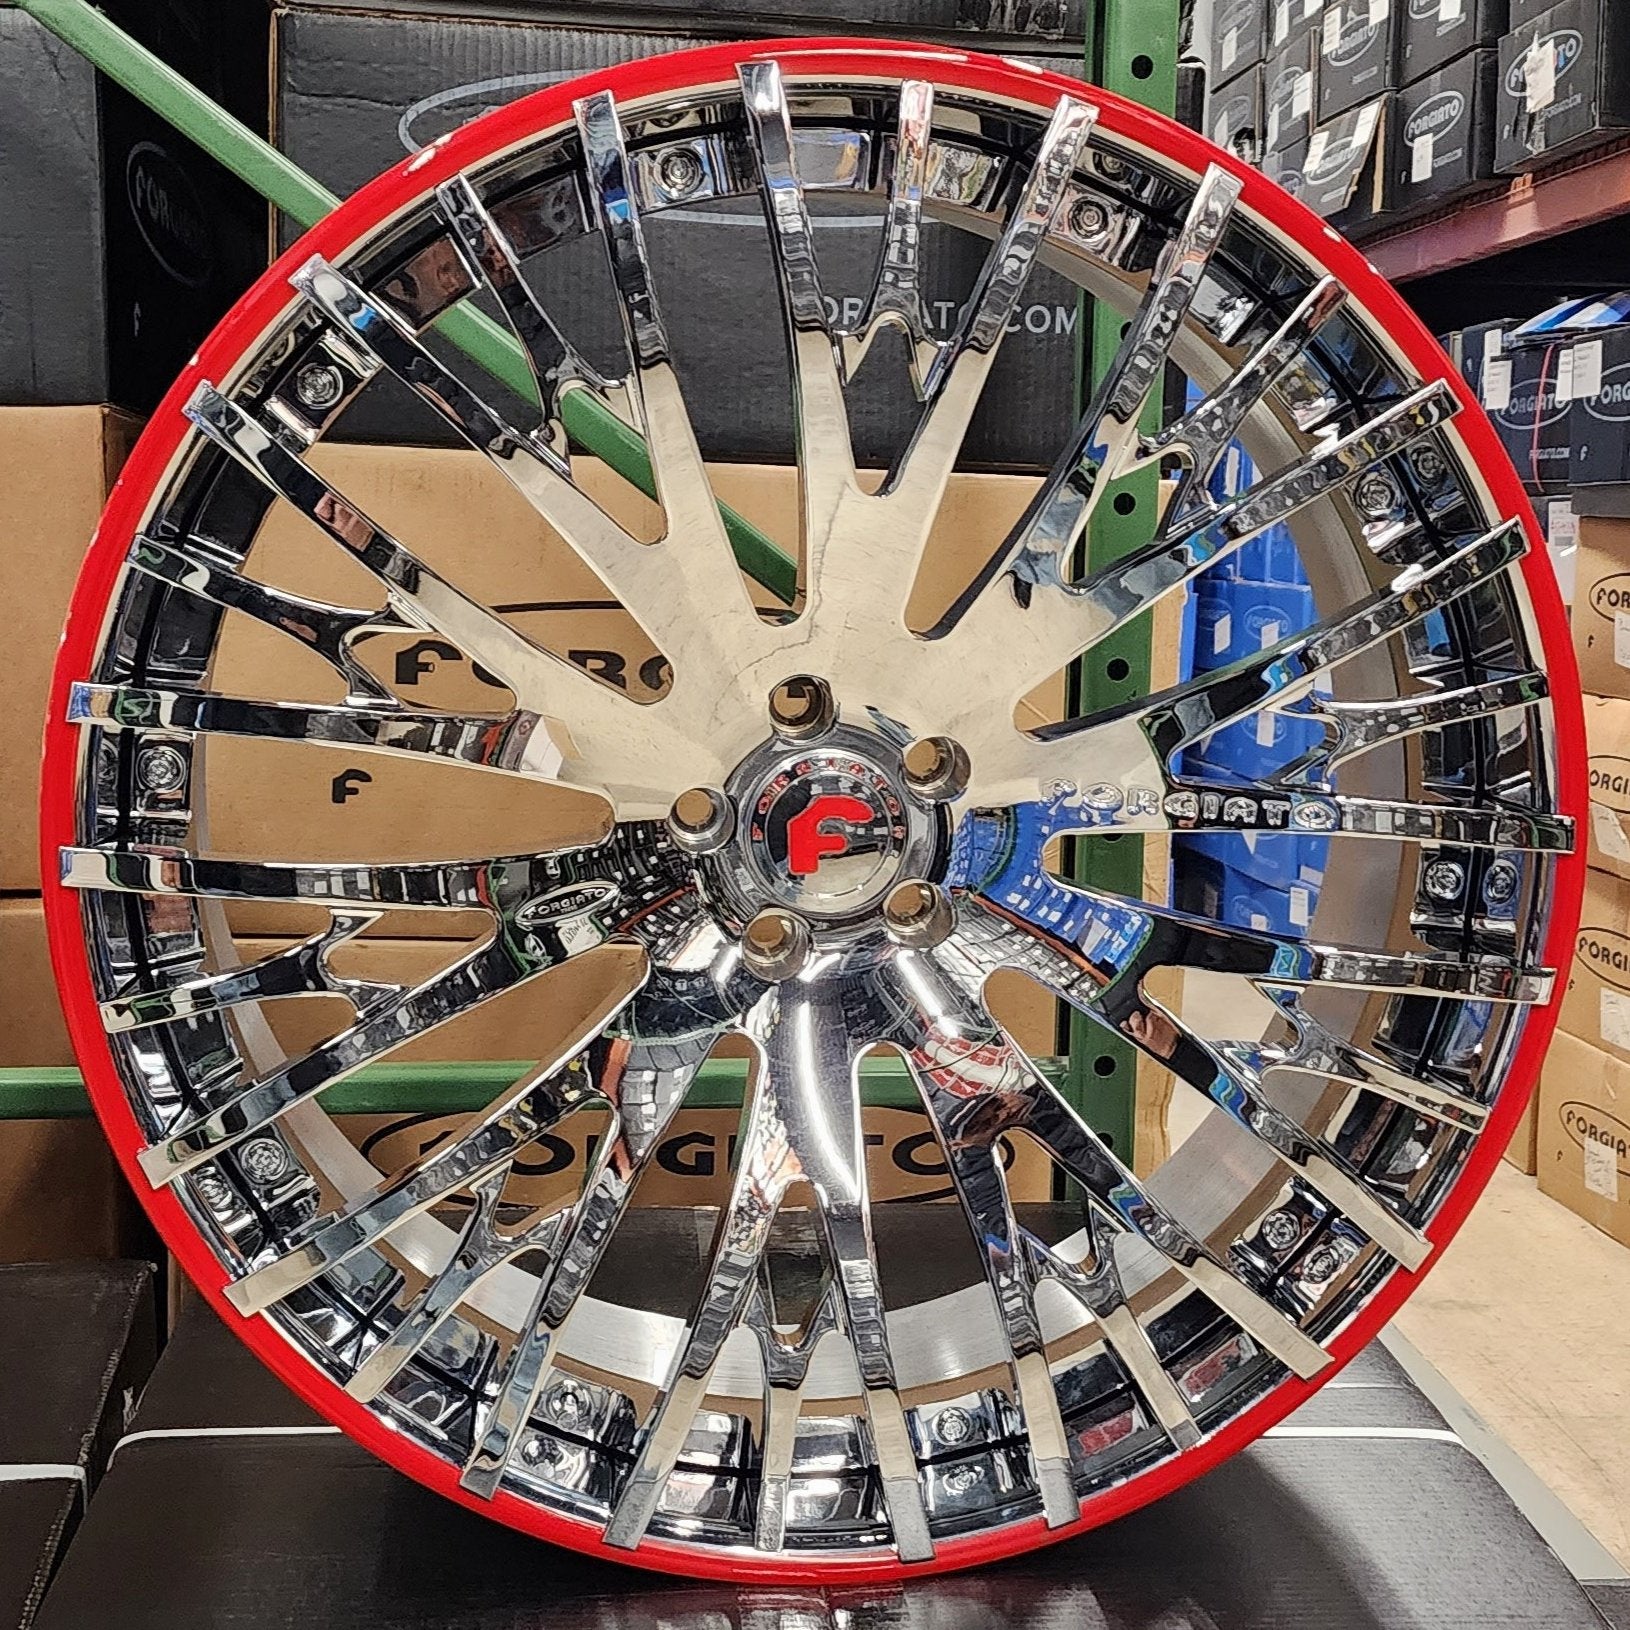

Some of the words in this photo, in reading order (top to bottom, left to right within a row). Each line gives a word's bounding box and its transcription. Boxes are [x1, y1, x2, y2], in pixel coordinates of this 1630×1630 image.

[1408, 98, 1459, 139] FORGIATO
[1578, 936, 1630, 972] FORGI
[1566, 1110, 1630, 1159] FORGIA
